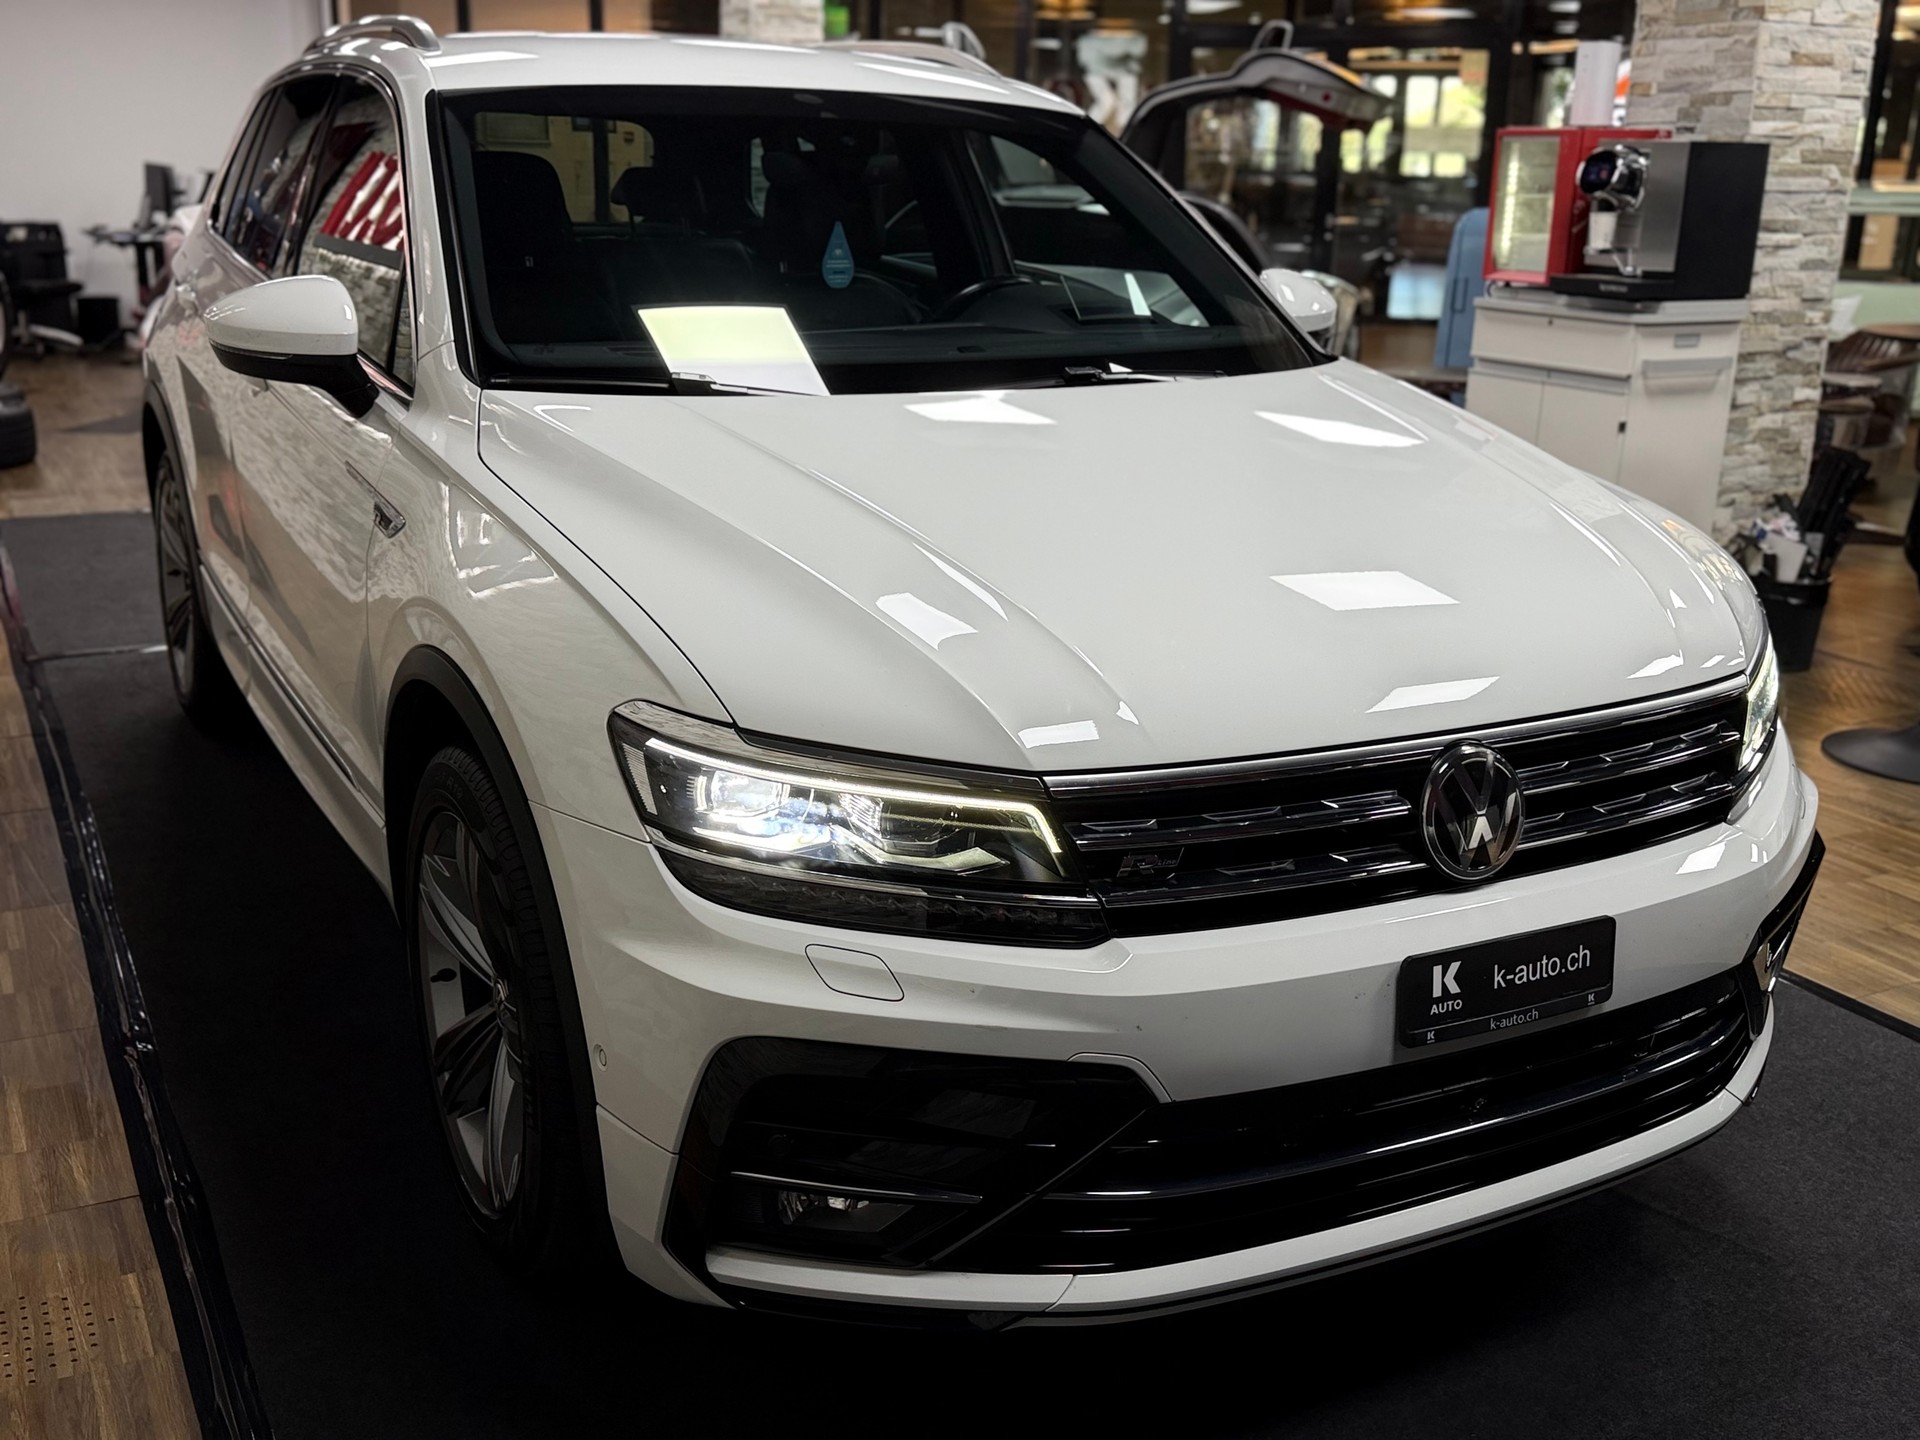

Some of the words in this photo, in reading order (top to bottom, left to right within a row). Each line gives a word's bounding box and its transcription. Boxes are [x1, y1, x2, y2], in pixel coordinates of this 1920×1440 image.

[1432, 960, 1462, 998] K
[1493, 945, 1591, 989] k-auto.ch
[1430, 999, 1463, 1015] AUTO
[1490, 1008, 1539, 1030] k-auto.ch
